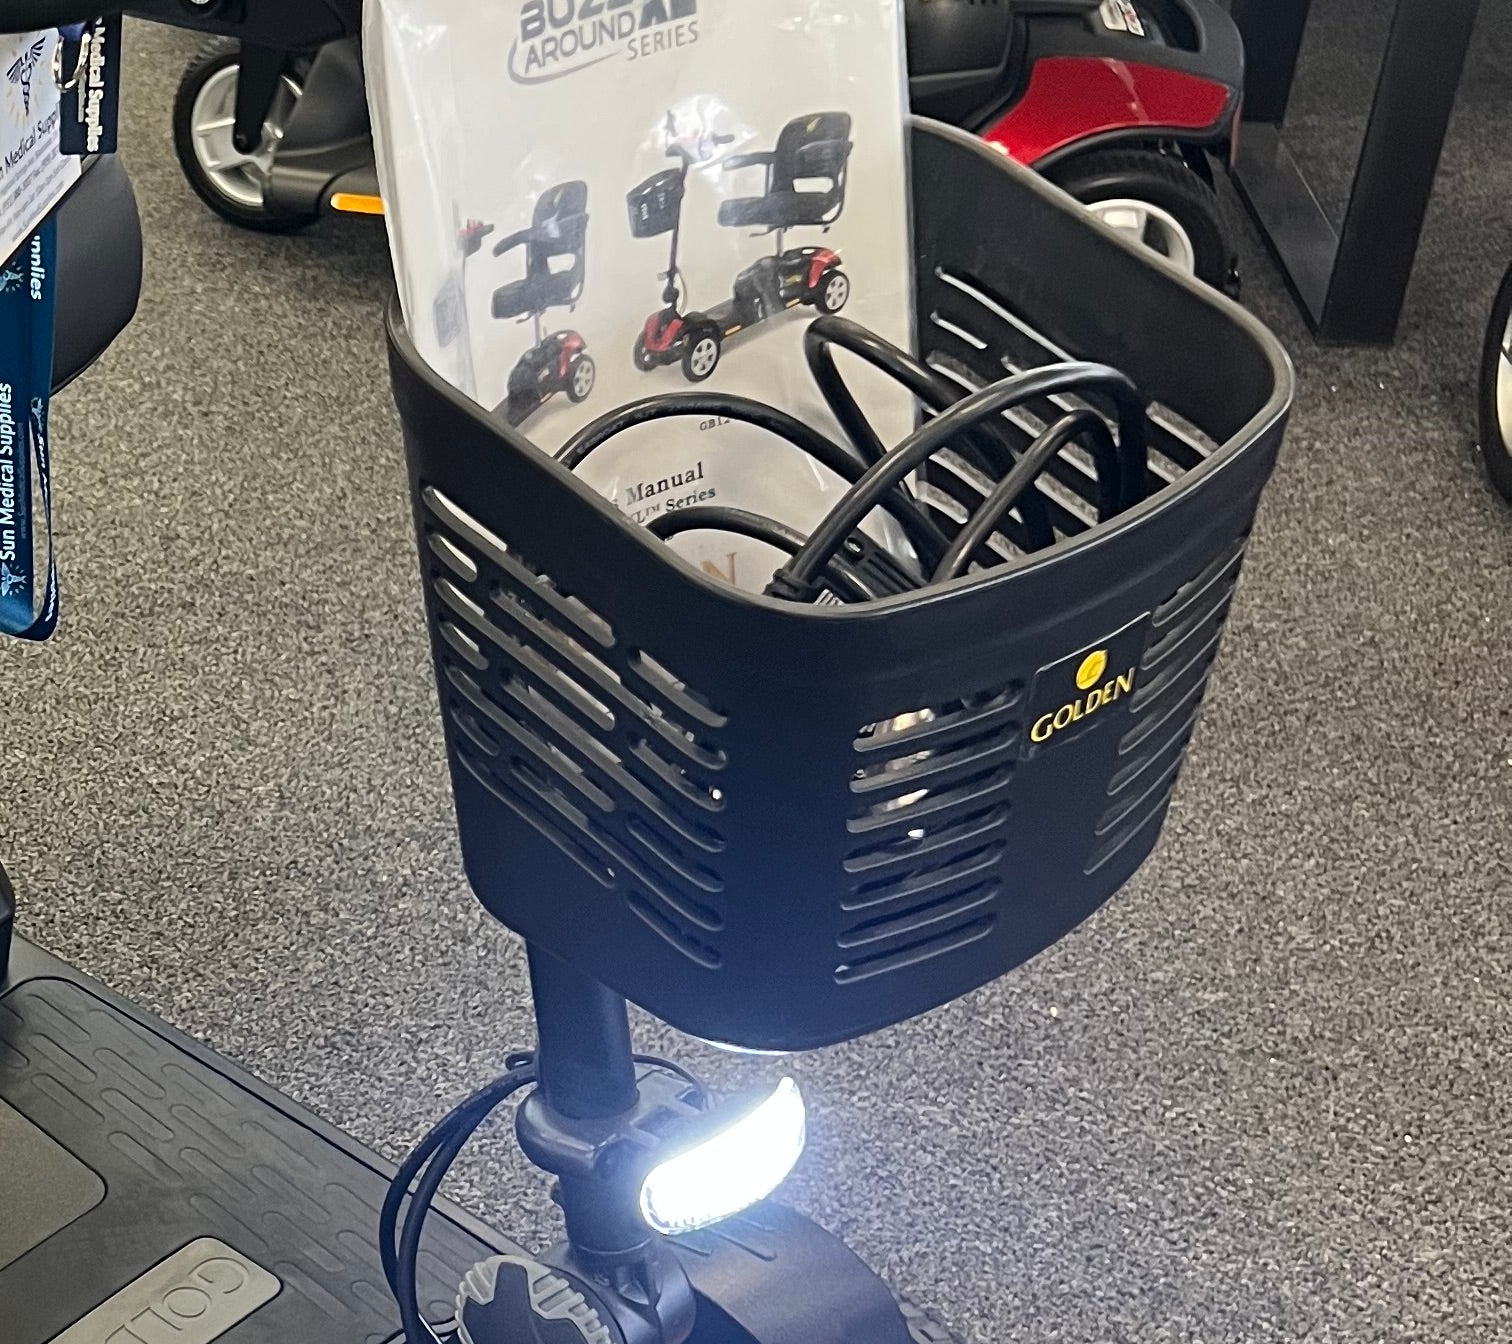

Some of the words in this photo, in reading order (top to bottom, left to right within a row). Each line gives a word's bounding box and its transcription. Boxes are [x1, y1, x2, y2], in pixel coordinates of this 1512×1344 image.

[88, 26, 106, 88] Medical
[524, 10, 636, 75] AROUND
[627, 20, 699, 62] SERIES
[4, 129, 37, 176] Medical
[37, 103, 59, 140] Suppl
[86, 89, 103, 153] Supplies
[625, 461, 704, 506] Manual
[665, 487, 716, 513] Series
[0, 528, 16, 561] Sun
[1030, 666, 1136, 742] GOLDEN
